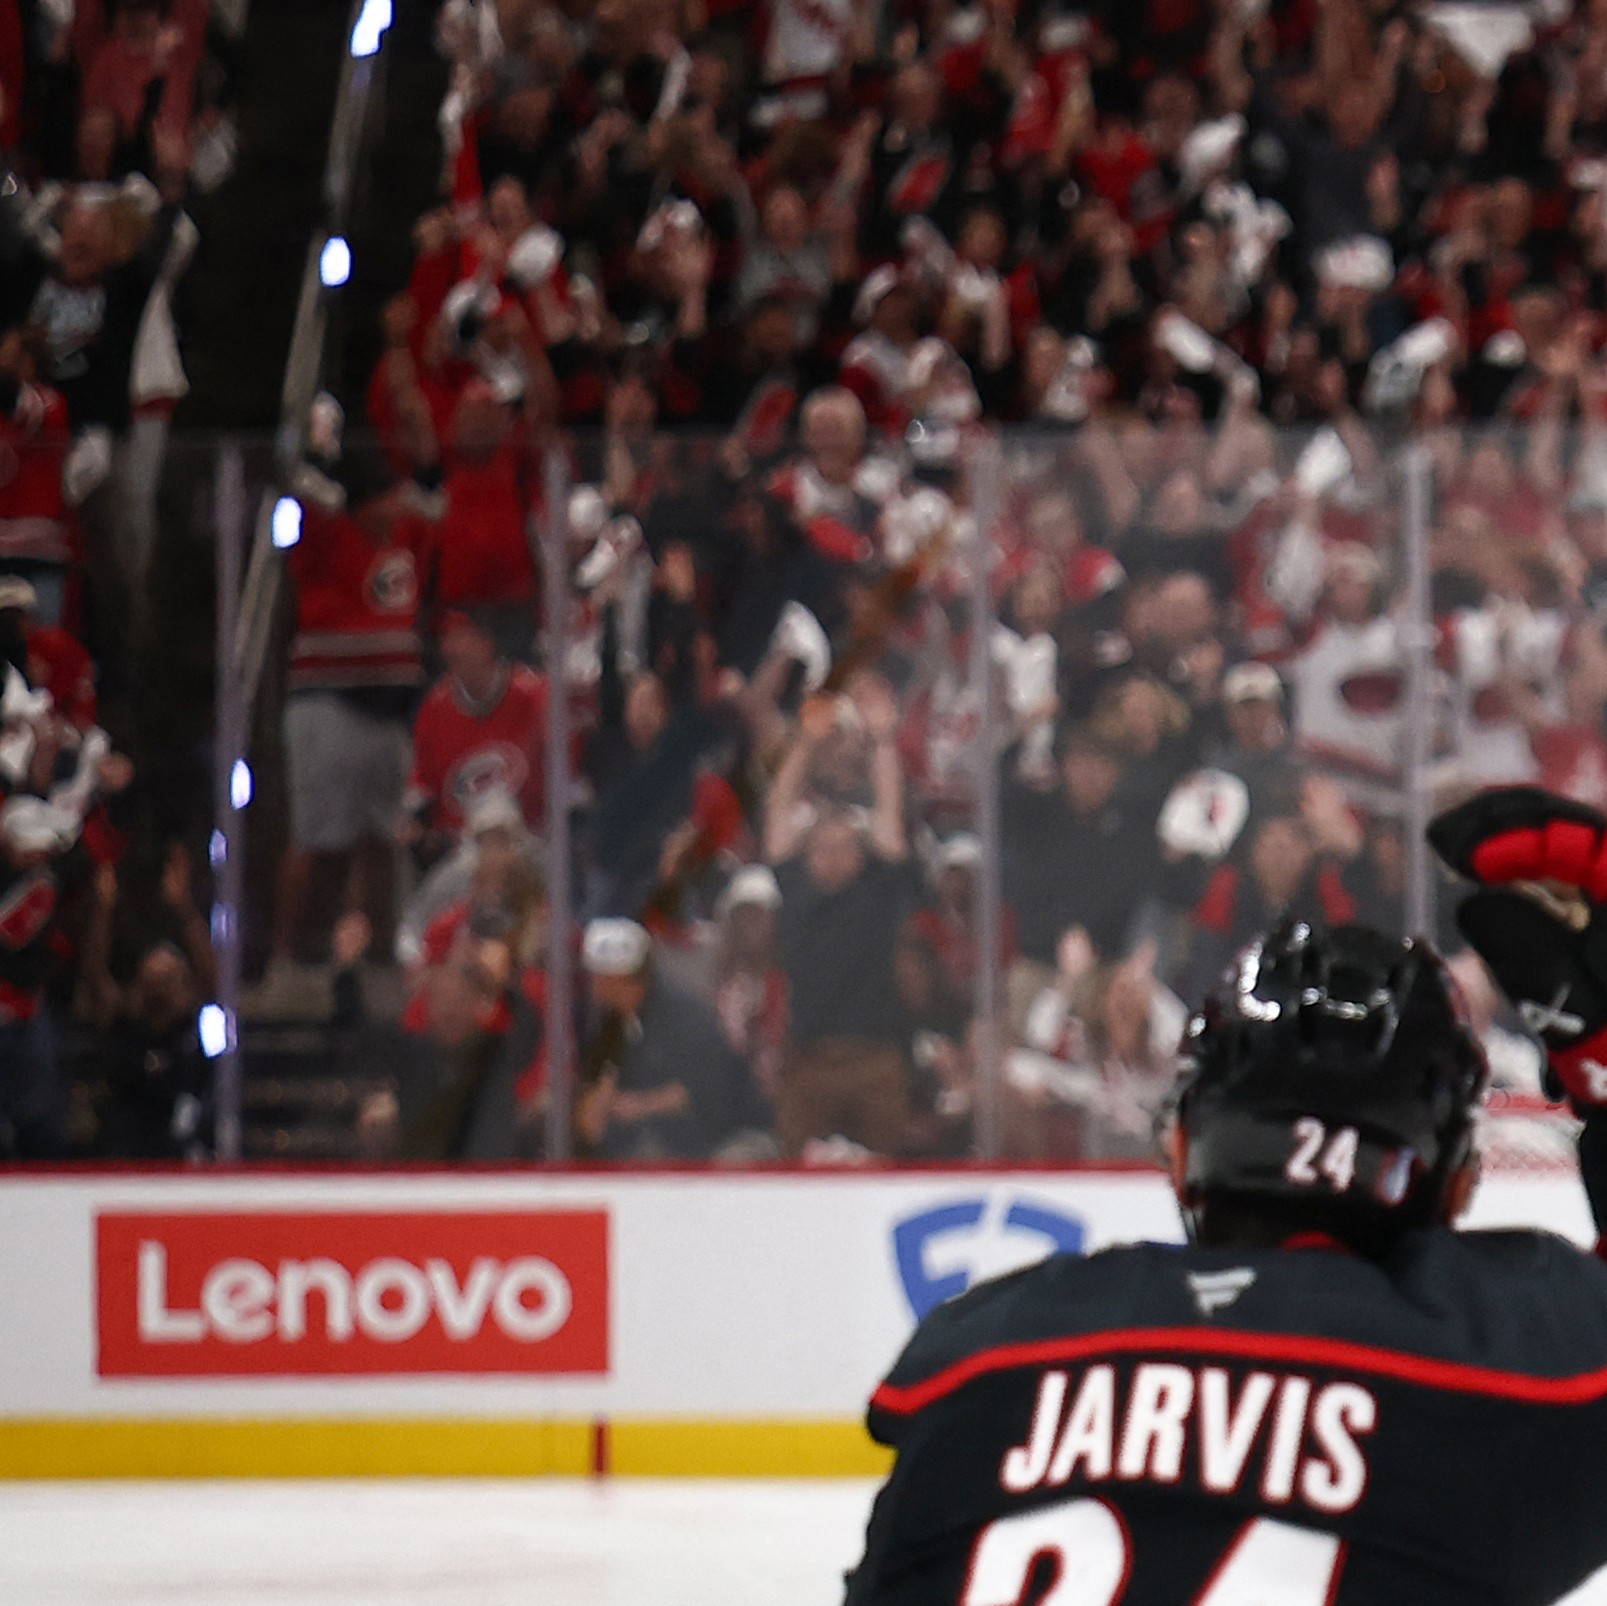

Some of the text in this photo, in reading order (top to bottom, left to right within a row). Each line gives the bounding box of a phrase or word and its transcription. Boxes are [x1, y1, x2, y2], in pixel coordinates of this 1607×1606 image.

[1286, 1115, 1360, 1192] 24
[136, 1239, 573, 1344] Lenovo
[1001, 1362, 1379, 1512] JARVIS
